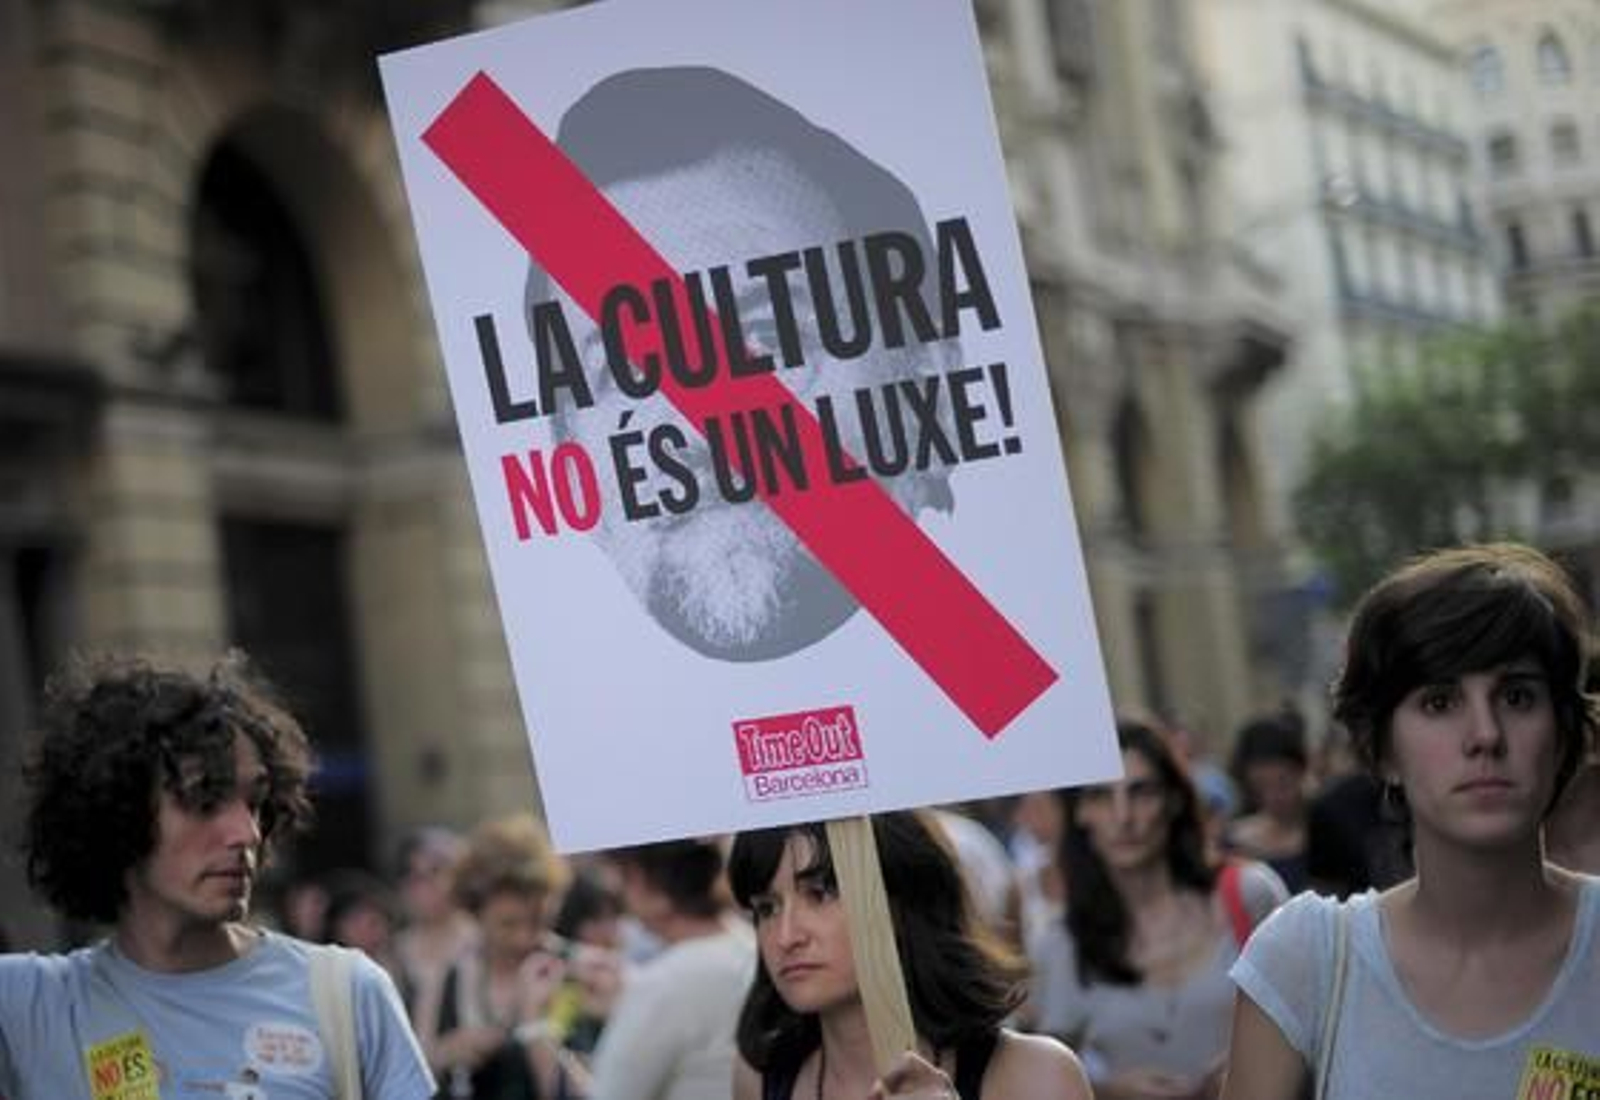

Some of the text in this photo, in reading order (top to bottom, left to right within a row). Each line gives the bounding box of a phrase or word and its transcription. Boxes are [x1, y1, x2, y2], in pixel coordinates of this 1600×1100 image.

[473, 216, 1002, 425] LA CULTURA
[500, 362, 1023, 541] NO ÉS UN LUXE!
[754, 765, 861, 797] Barcelona
